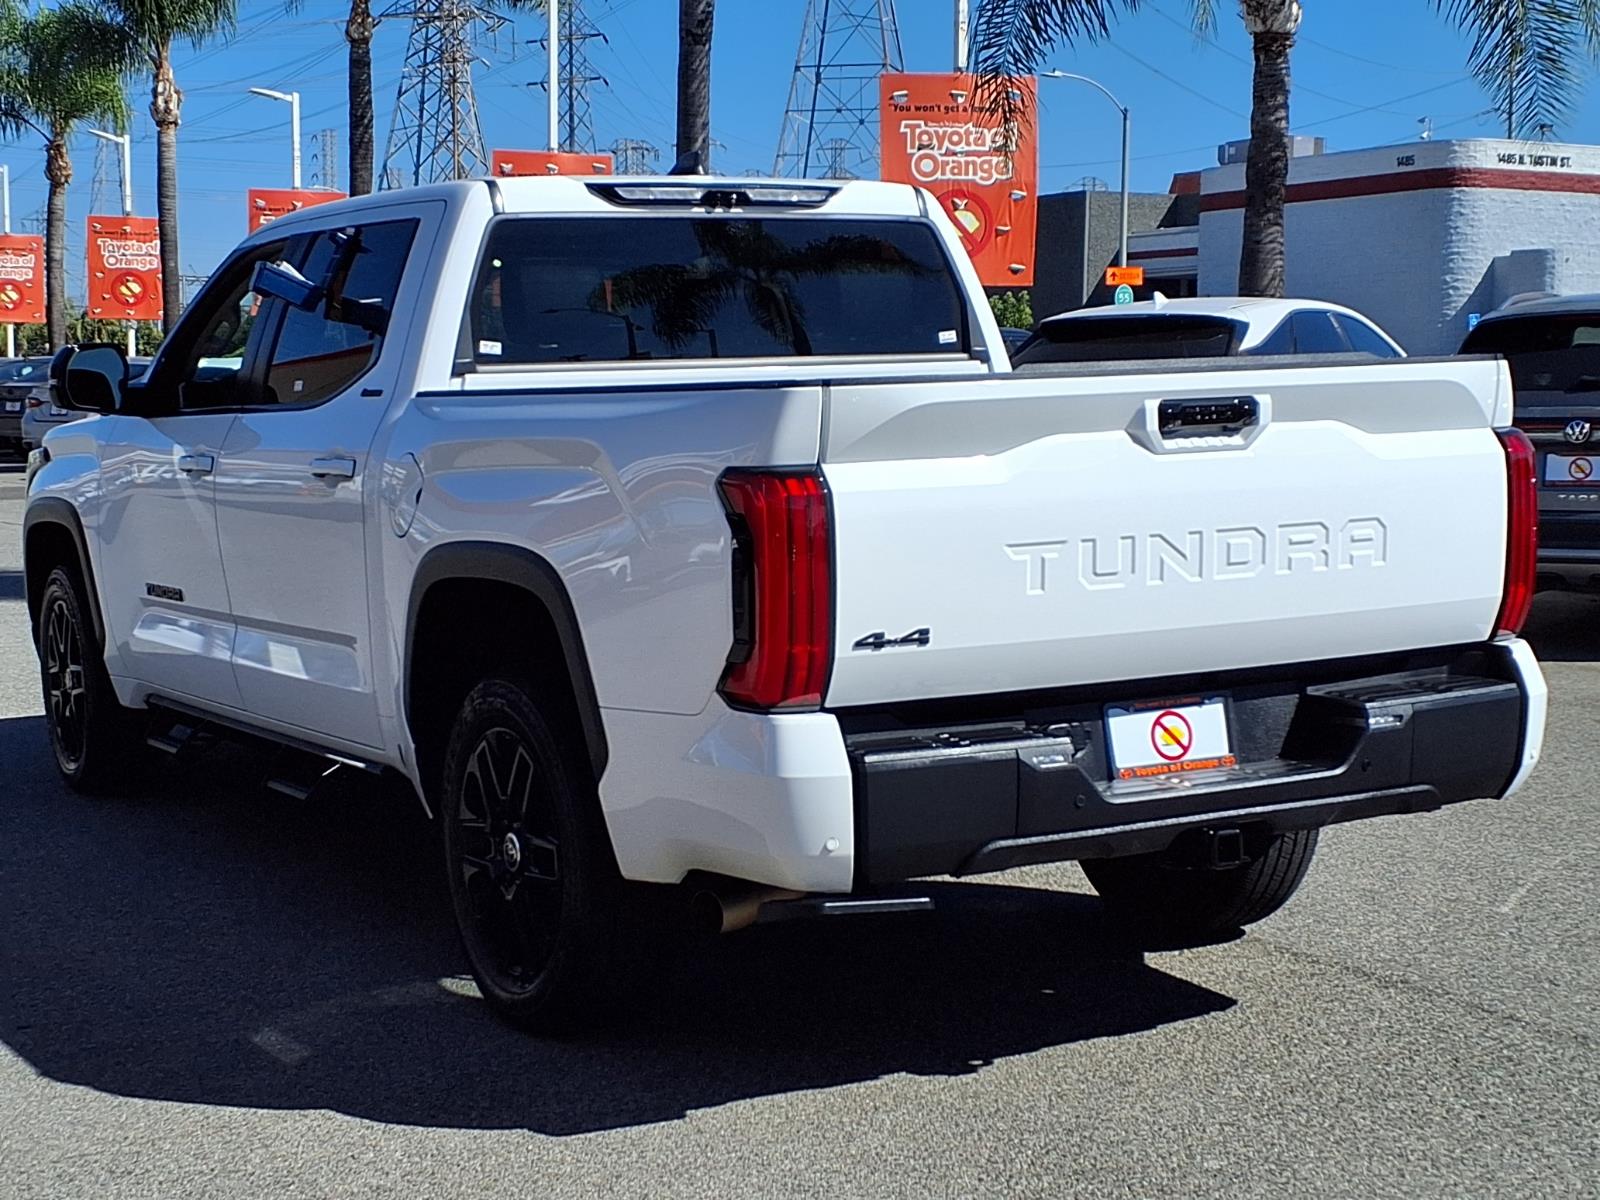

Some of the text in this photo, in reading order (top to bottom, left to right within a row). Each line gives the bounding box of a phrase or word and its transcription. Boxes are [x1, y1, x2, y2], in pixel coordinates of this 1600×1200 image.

[914, 103, 941, 112] won't
[943, 105, 960, 115] get
[901, 120, 989, 154] Toyota
[911, 150, 1013, 185] Orange
[1396, 155, 1416, 168] 1485
[1497, 152, 1517, 165] 1485
[1527, 154, 1558, 167] TUSTIN
[97, 238, 144, 255] Toyota
[104, 254, 160, 270] Orange
[1119, 293, 1130, 303] 55
[1003, 516, 1387, 596] TUNDRA
